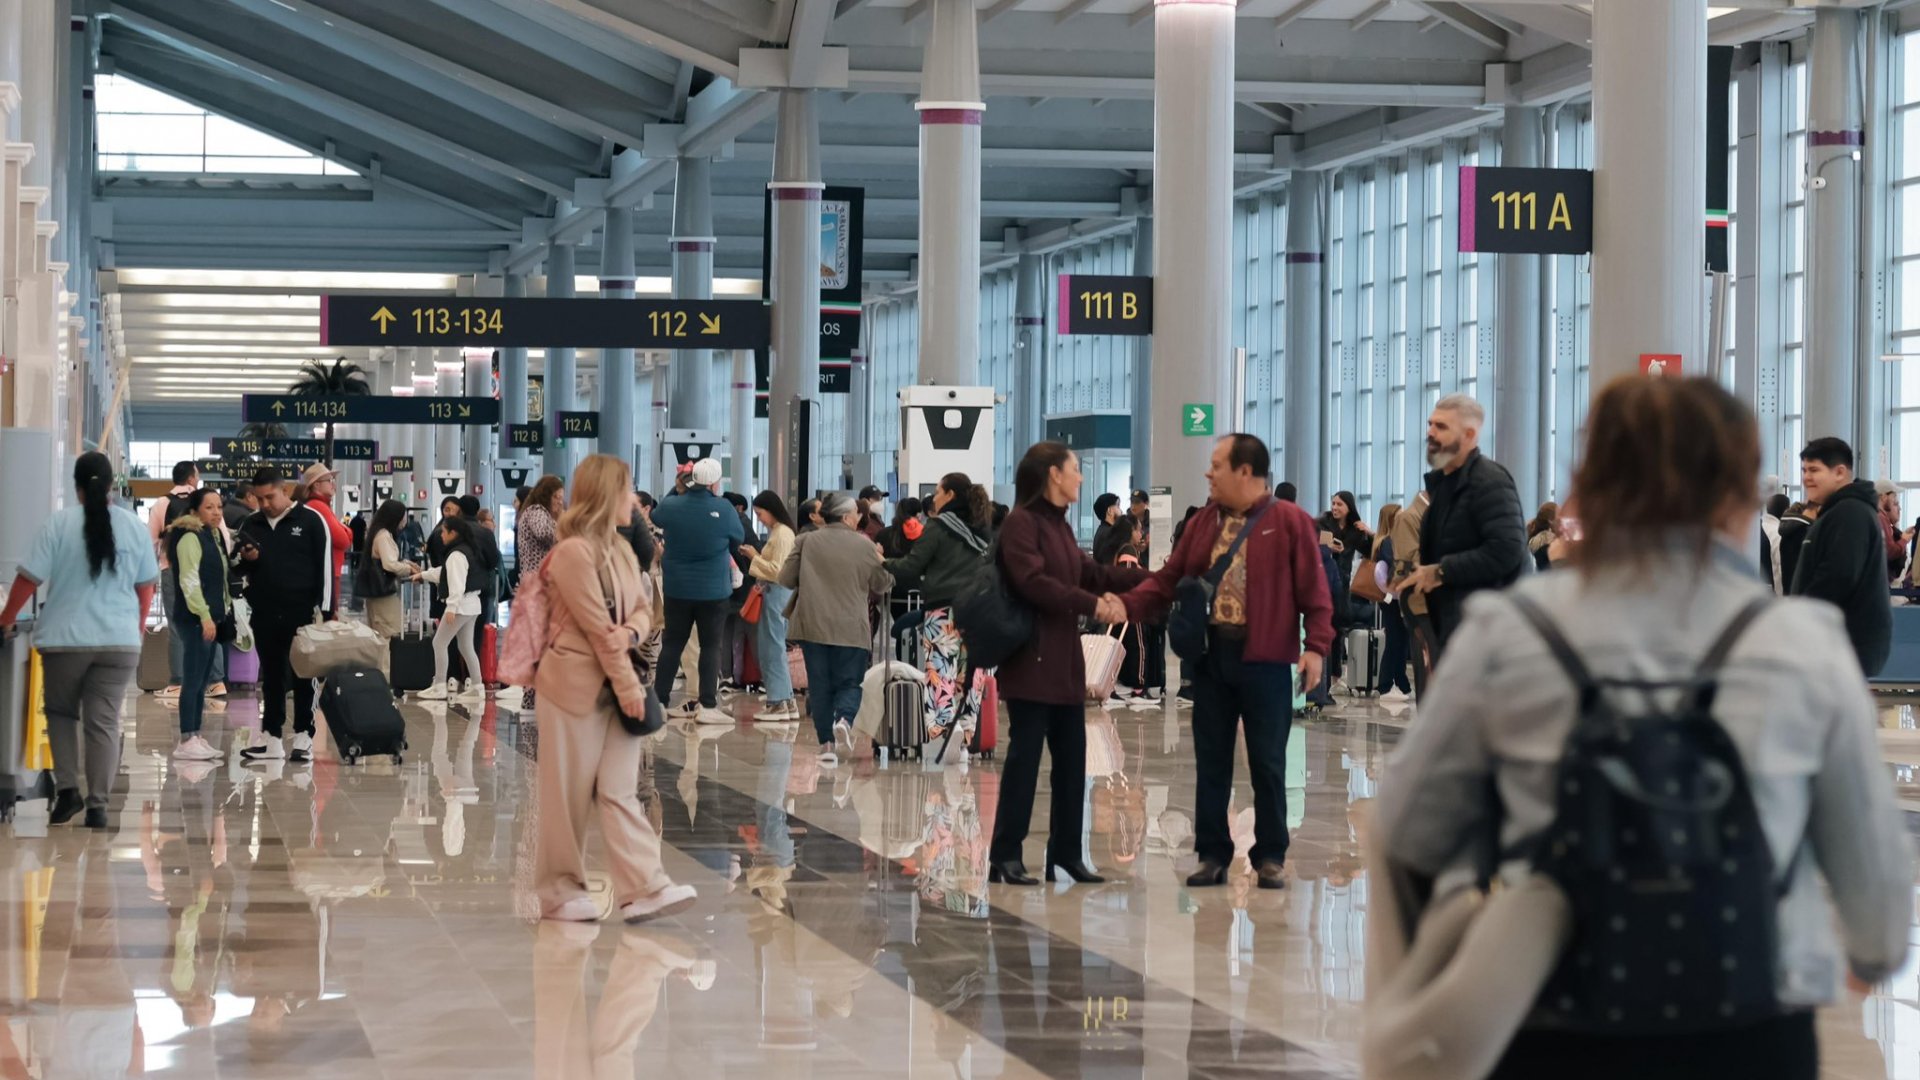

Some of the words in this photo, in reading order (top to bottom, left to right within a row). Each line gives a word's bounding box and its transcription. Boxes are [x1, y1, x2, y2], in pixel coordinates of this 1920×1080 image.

[1491, 192, 1536, 230] 111
[1548, 192, 1572, 231] A
[1080, 291, 1113, 319] 111
[1123, 291, 1138, 320] B
[412, 307, 504, 335] 113-134
[648, 310, 688, 337] 112
[294, 401, 347, 417] 114-134
[429, 403, 451, 418] 113
[564, 418, 581, 432] 112
[583, 418, 592, 432] A
[513, 430, 529, 442] 112
[531, 431, 538, 442] B
[294, 445, 326, 456] 114-13
[344, 445, 360, 456] 113
